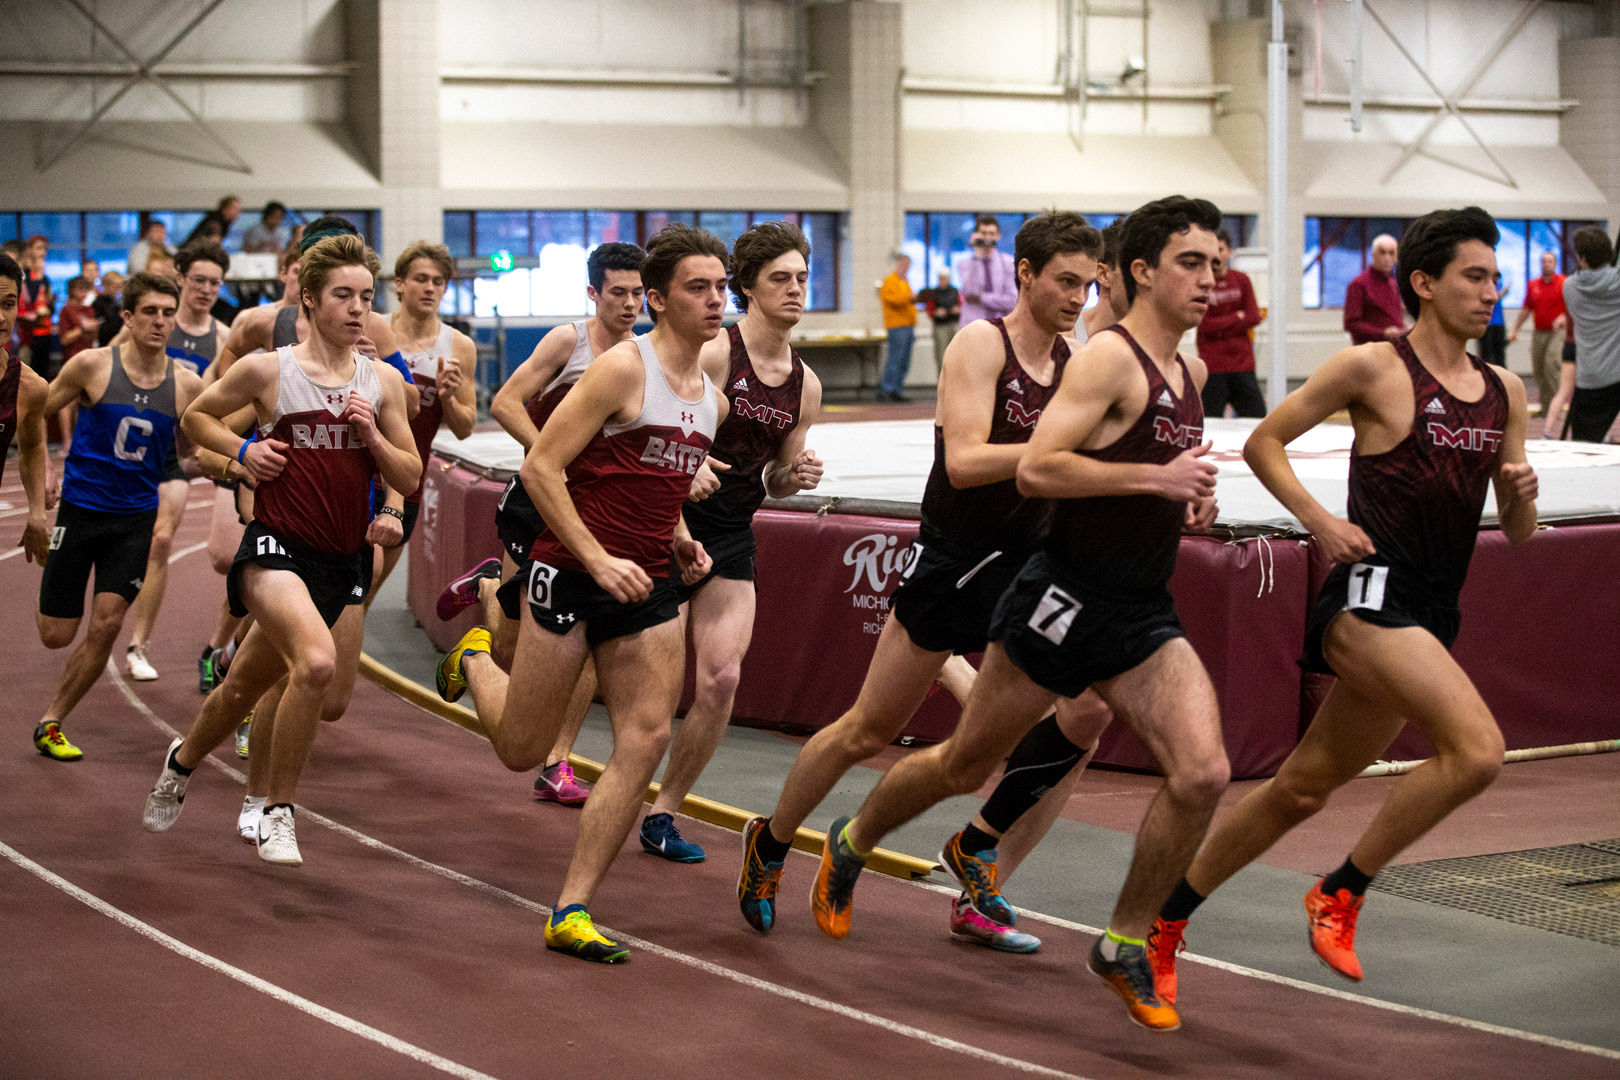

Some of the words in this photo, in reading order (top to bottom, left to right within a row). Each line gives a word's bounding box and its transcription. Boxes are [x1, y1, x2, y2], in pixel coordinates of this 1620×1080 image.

[734, 397, 793, 430] MIT
[1153, 415, 1203, 449] MIT
[113, 416, 153, 461] C
[1427, 422, 1503, 453] MIT
[531, 566, 550, 604] 6
[1355, 567, 1374, 604] 1
[1037, 591, 1075, 632] 7
